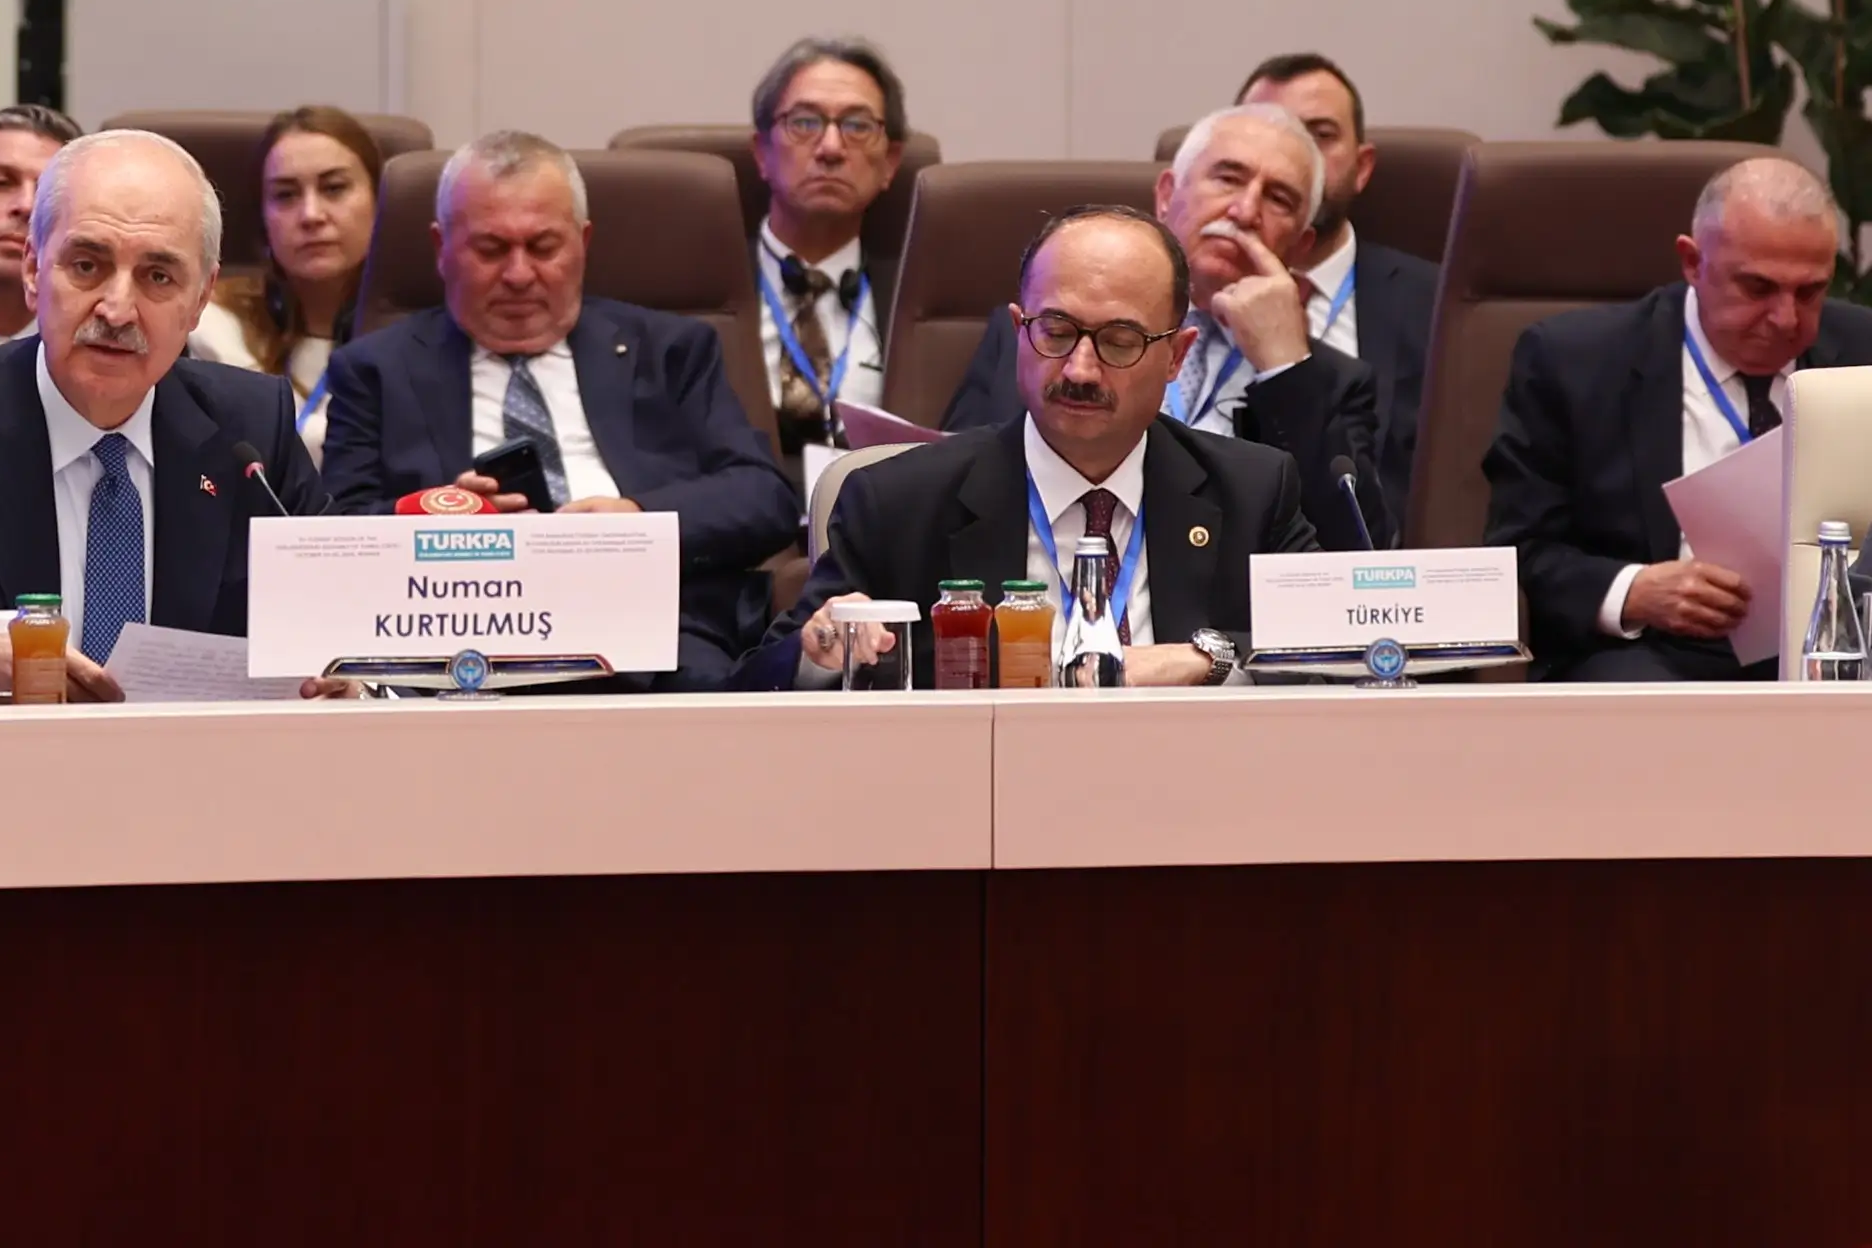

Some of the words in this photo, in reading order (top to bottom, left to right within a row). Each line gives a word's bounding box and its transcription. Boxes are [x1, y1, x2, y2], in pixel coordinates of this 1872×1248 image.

[418, 533, 512, 550] TURKPA
[1355, 568, 1415, 582] TURKPA
[407, 575, 523, 599] Numan
[375, 611, 553, 640] KURTULMUŞ
[1346, 603, 1424, 626] TÜRKİYE
